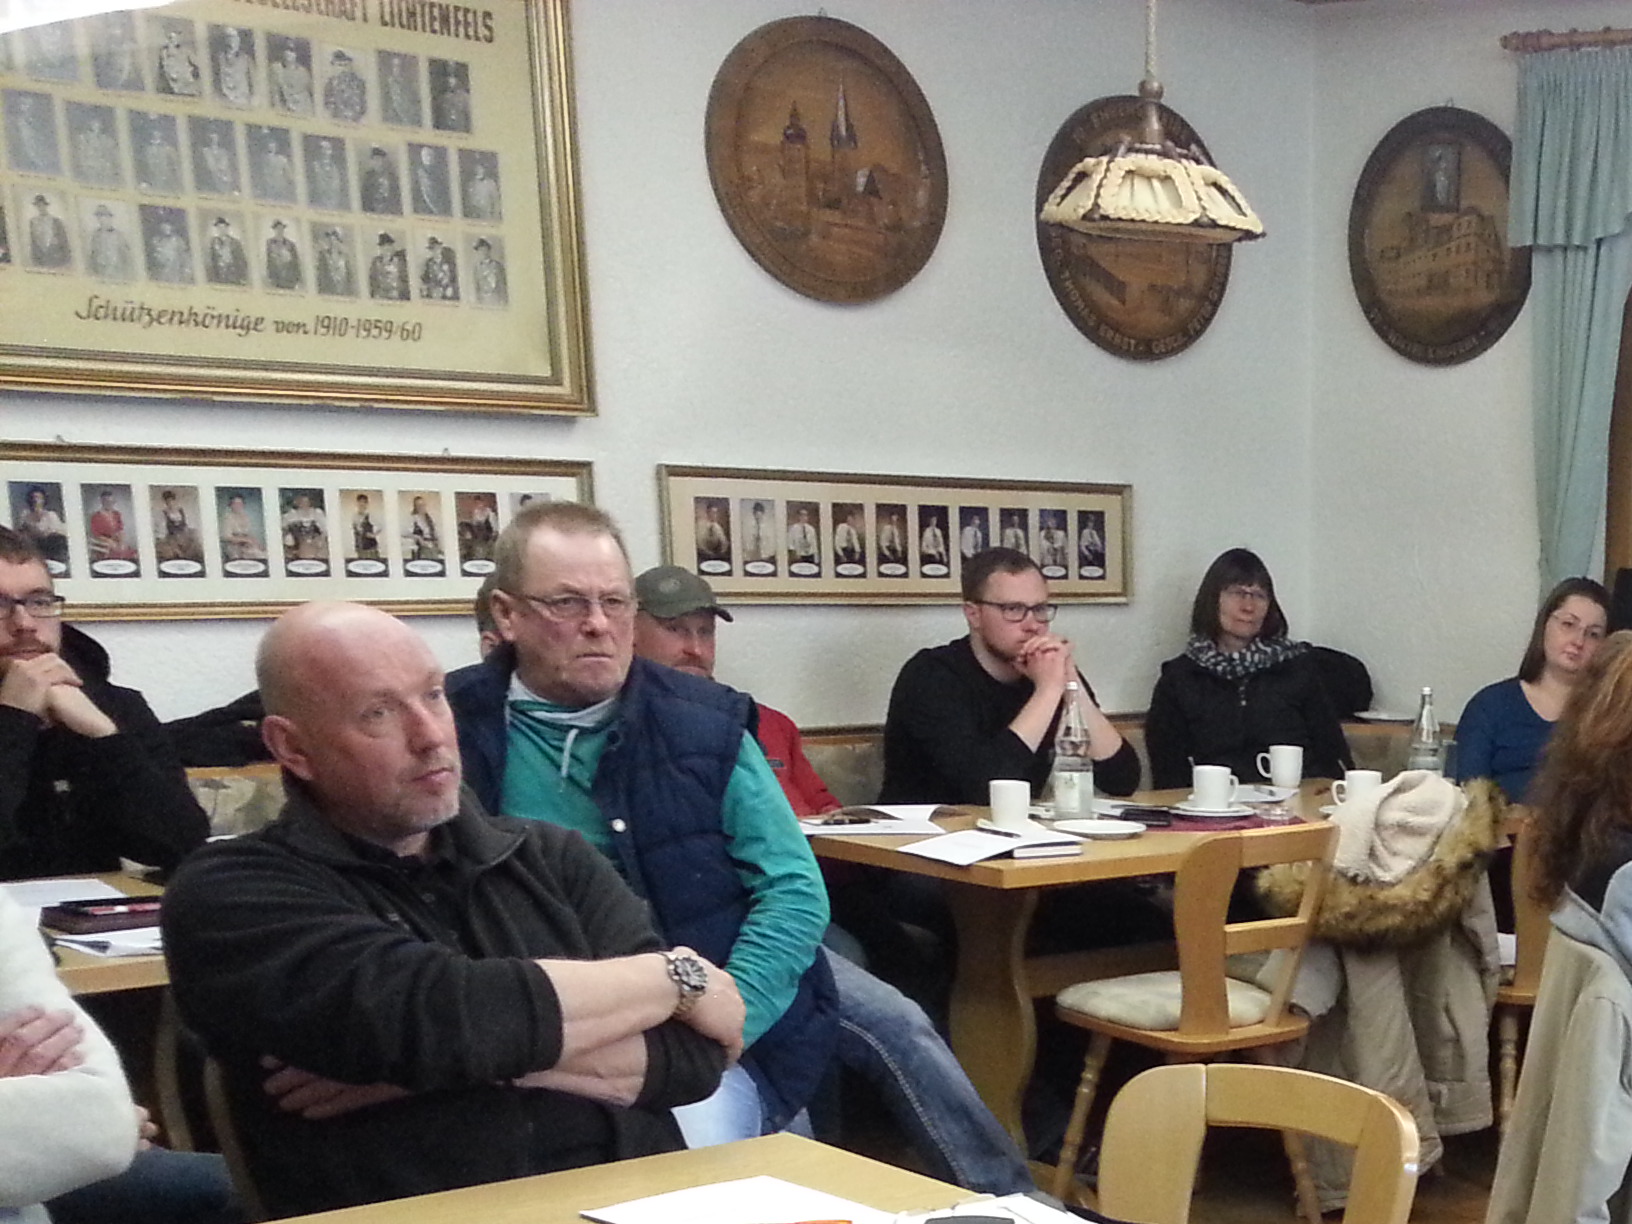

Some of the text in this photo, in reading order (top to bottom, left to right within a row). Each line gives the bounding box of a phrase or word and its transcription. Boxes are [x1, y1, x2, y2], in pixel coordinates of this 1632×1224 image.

[380, 0, 495, 43] LICHTENFELS
[75, 294, 265, 338] Schützenkönige
[274, 319, 308, 336] von
